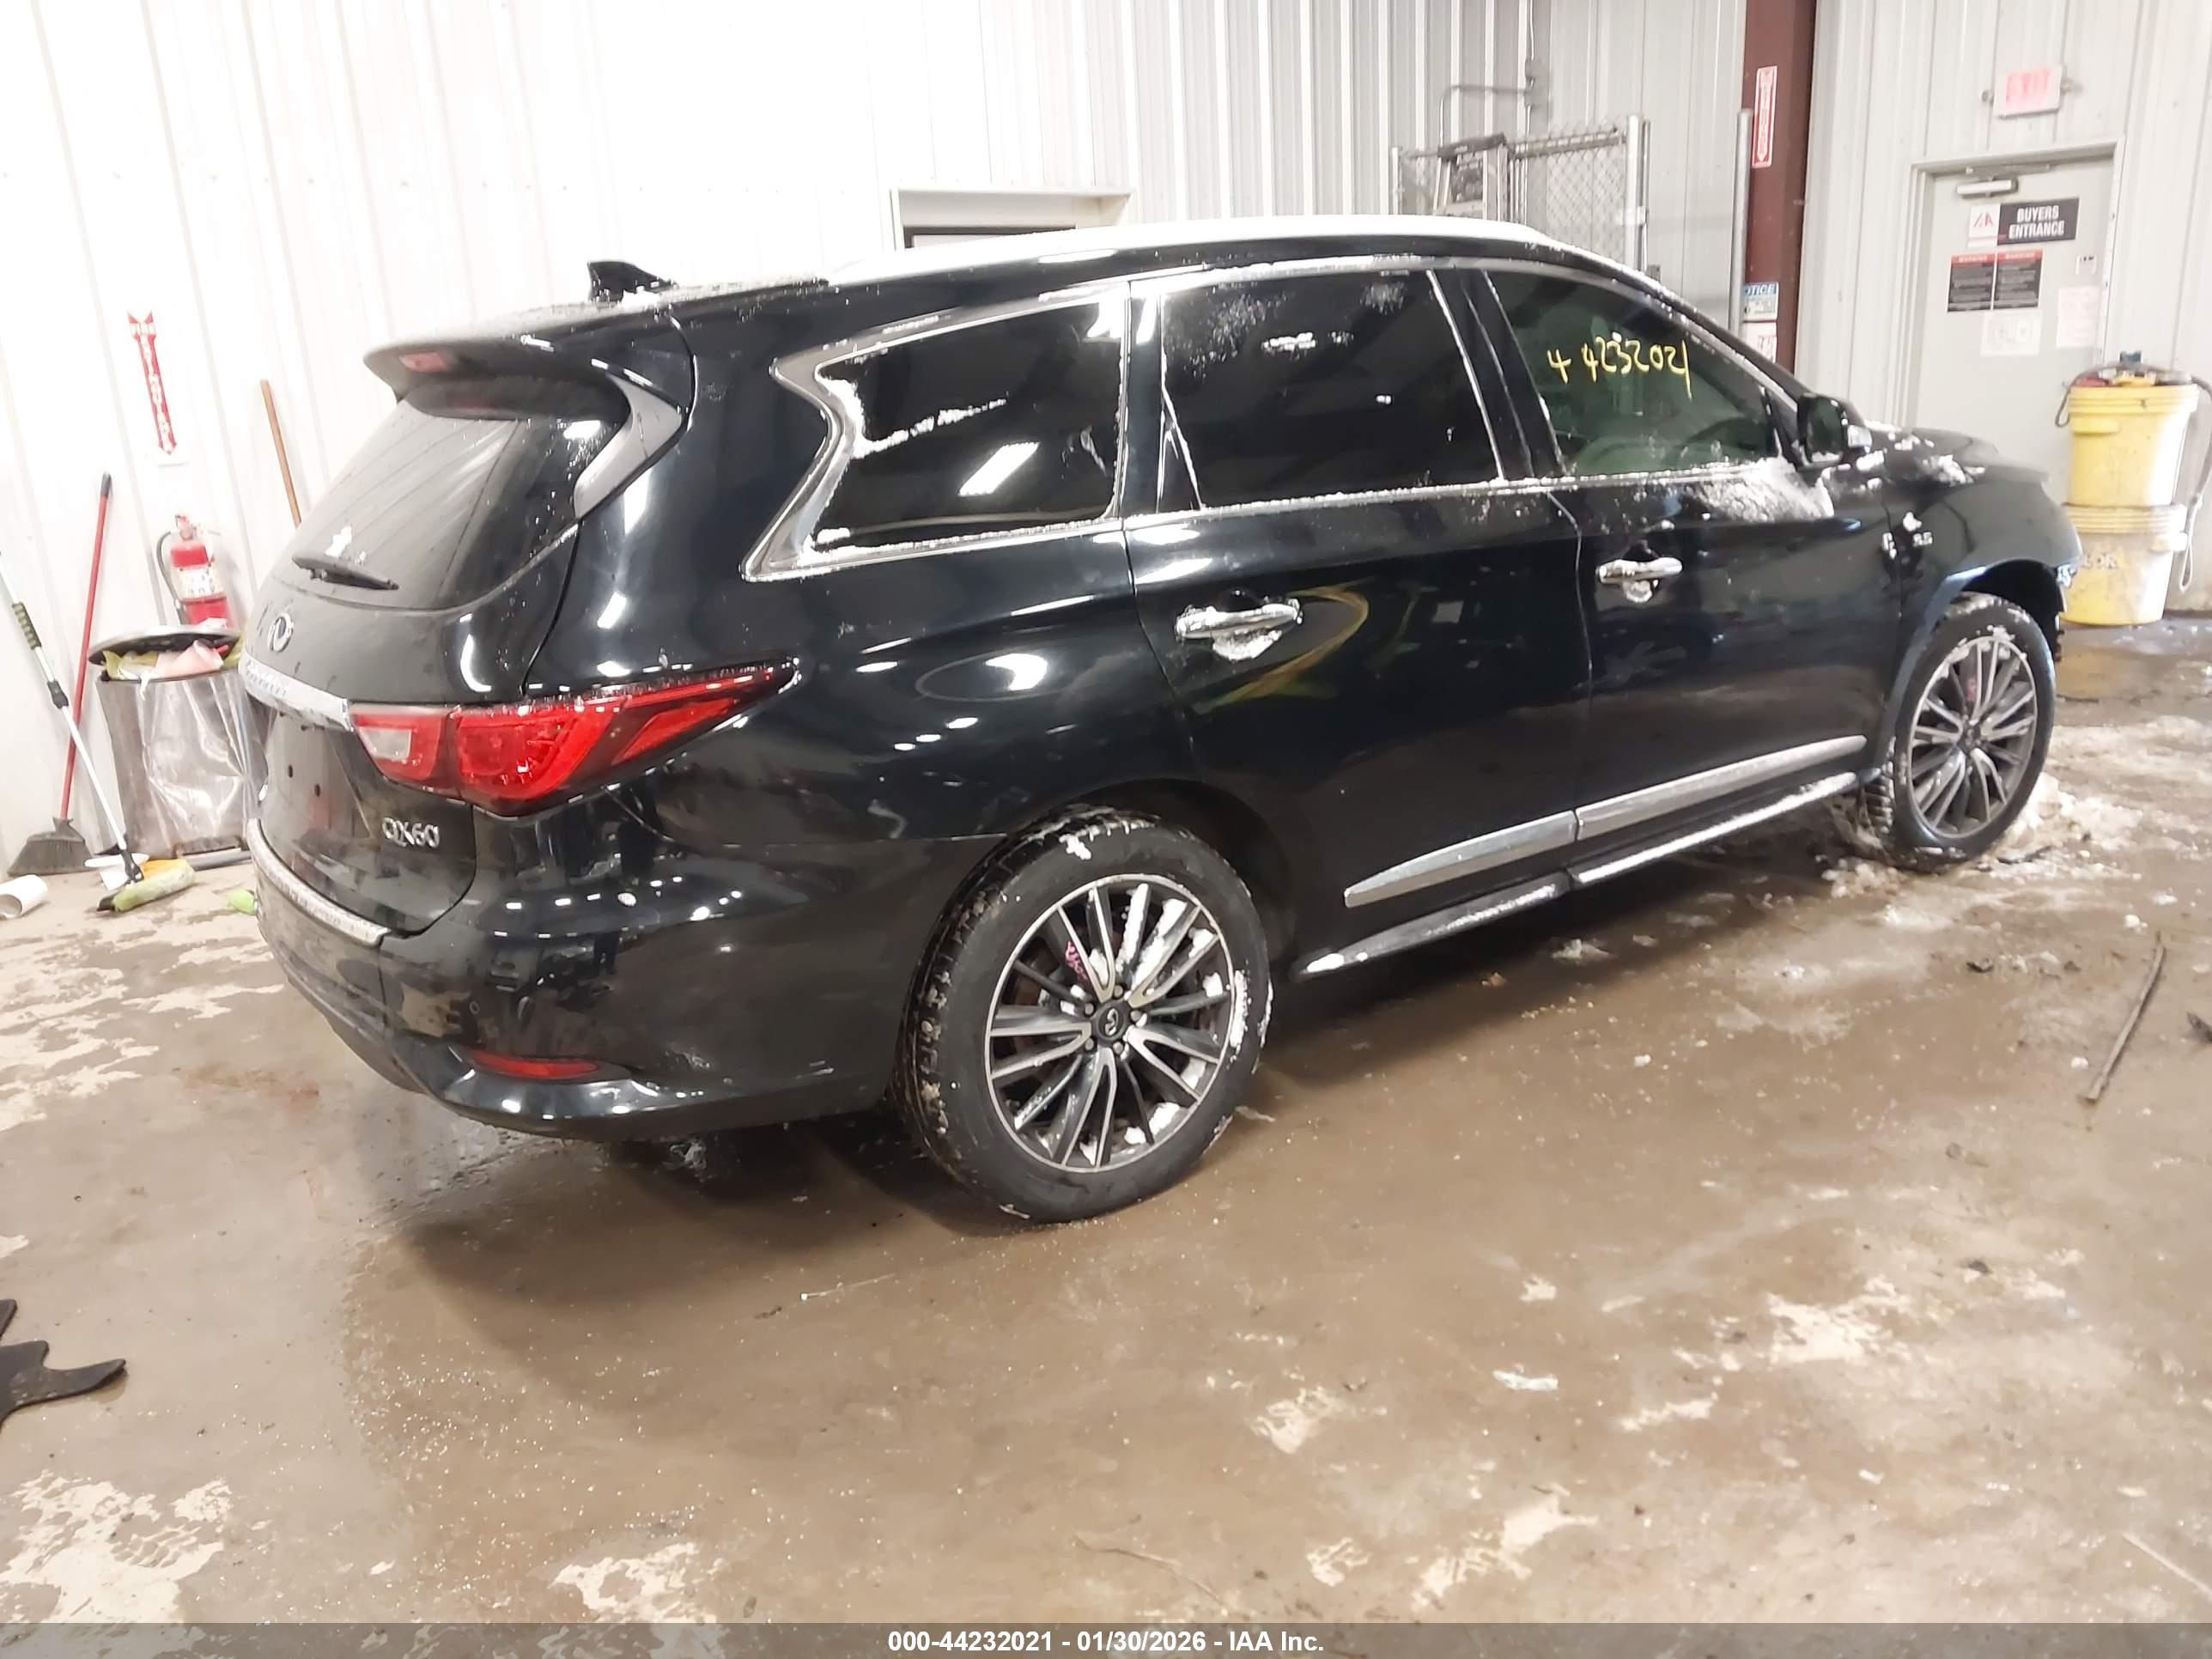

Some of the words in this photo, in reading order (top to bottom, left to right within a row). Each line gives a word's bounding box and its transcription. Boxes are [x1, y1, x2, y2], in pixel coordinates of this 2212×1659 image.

[2016, 204, 2060, 223] BUYERS
[2008, 220, 2065, 240] ENTRANCE
[382, 817, 441, 848] QX60
